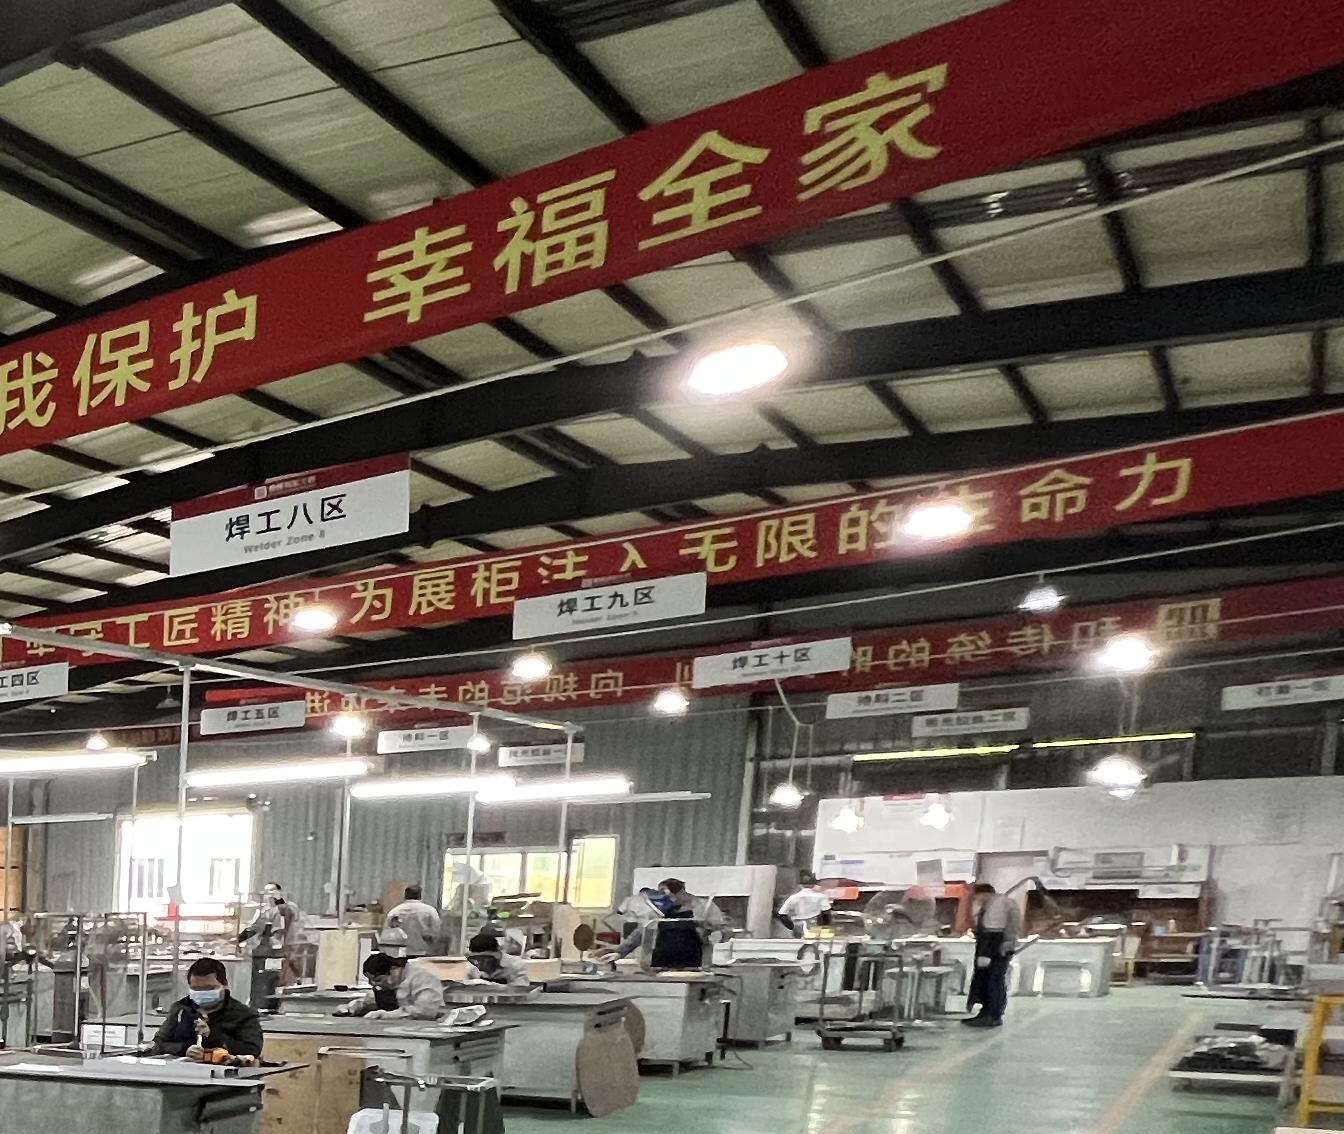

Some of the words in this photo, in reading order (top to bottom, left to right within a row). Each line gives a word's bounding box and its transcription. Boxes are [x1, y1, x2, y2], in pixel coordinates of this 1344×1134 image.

[362, 61, 950, 327] 幸福全家
[225, 494, 347, 542] 焊工八区
[243, 540, 281, 554] Welder
[286, 534, 314, 546] Zone
[557, 585, 656, 617] 焊工九区
[731, 646, 812, 671] 焊工十区
